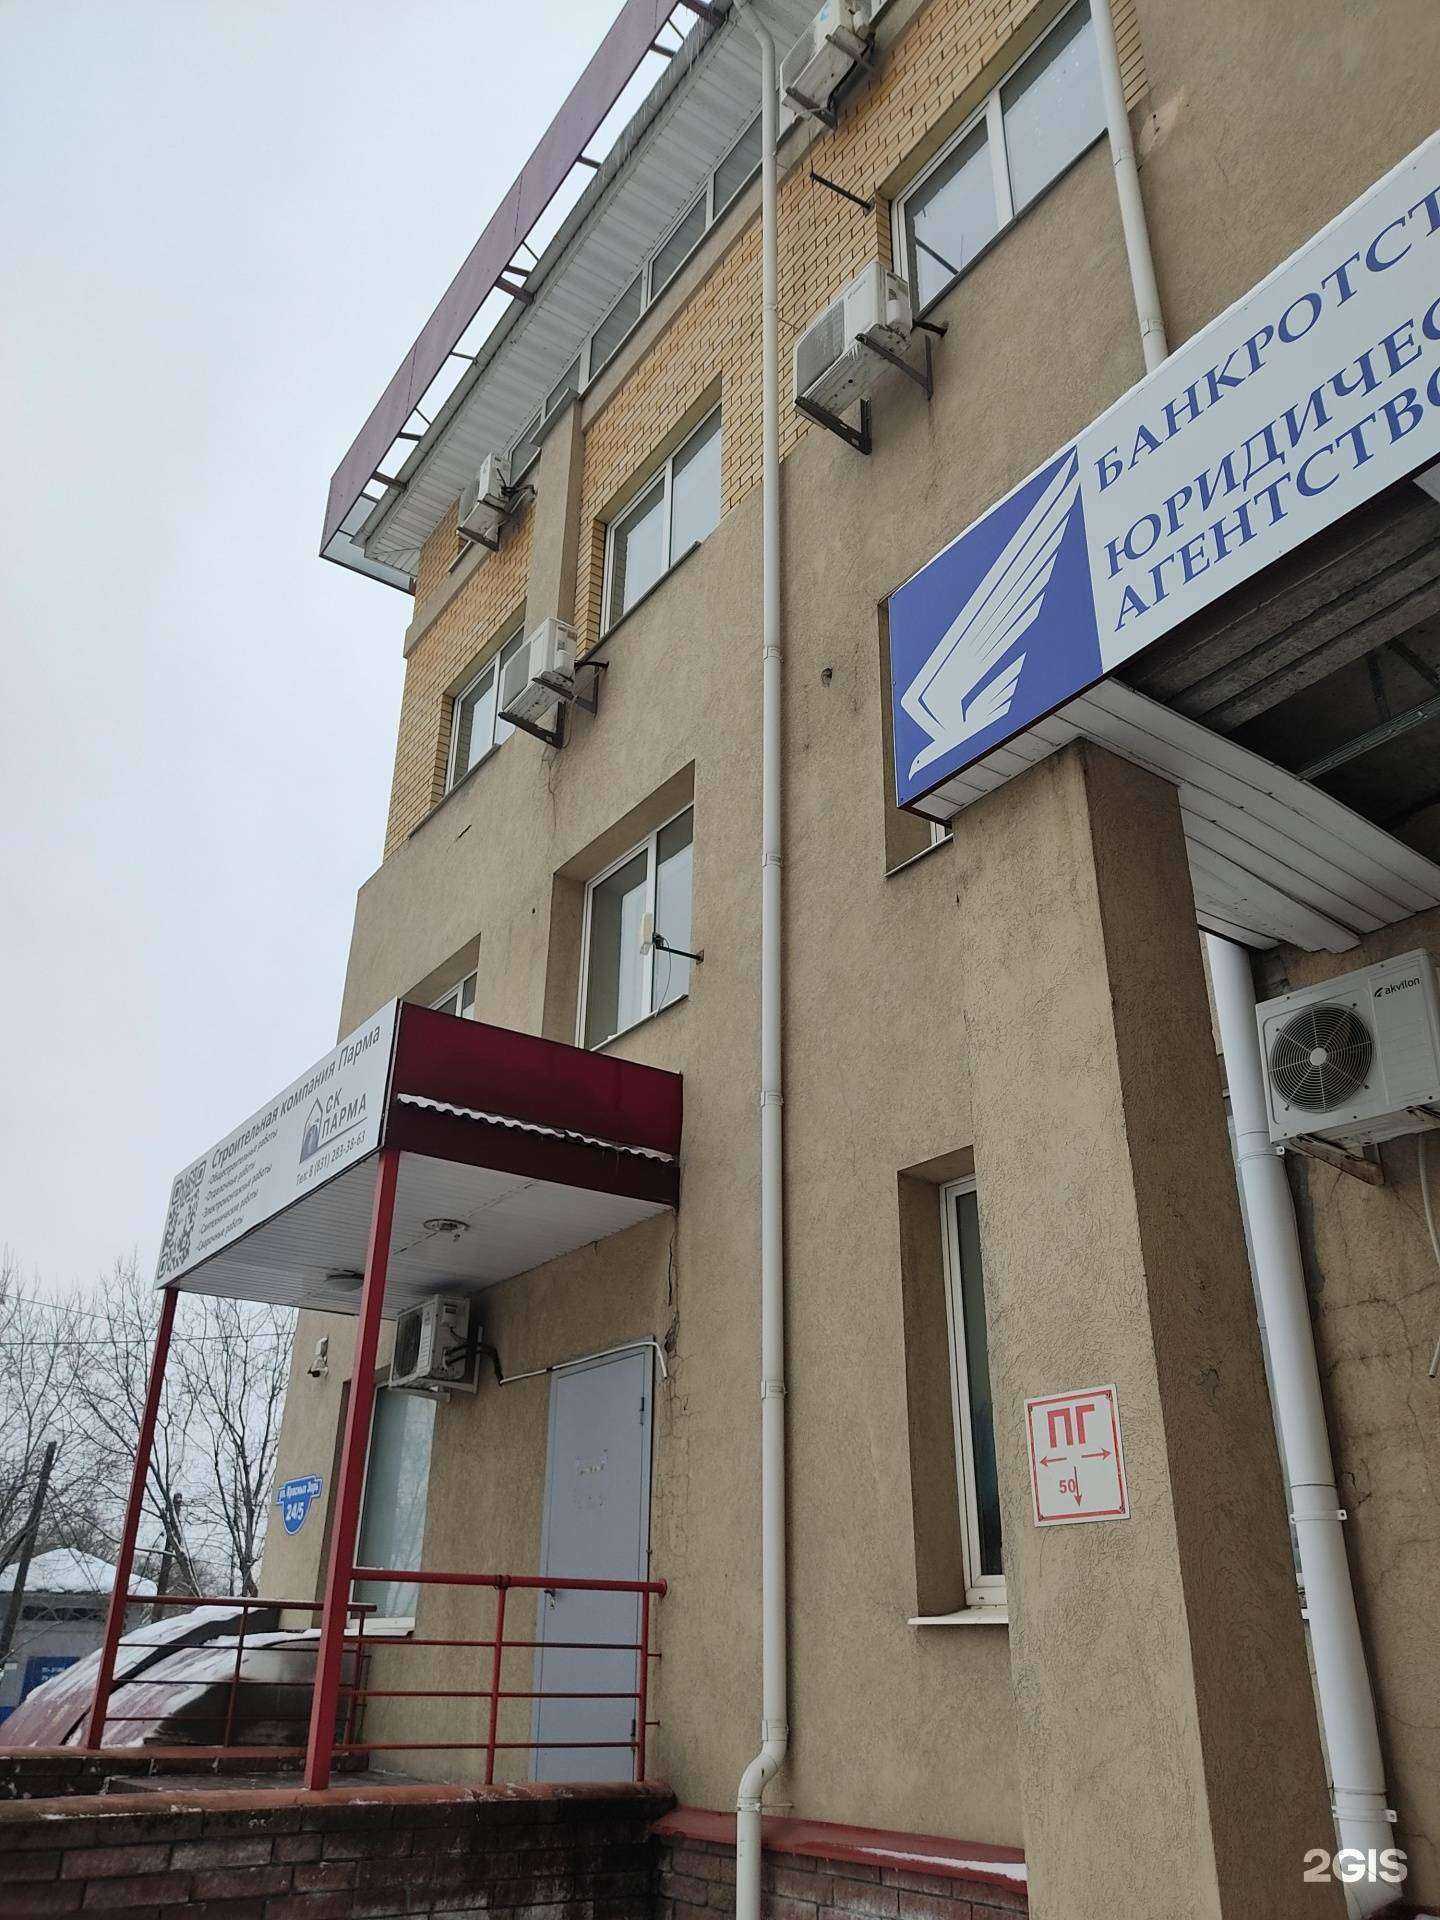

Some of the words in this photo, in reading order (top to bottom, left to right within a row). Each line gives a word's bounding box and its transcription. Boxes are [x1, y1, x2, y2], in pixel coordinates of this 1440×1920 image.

[1384, 977, 1420, 995] akvilon
[211, 1106, 279, 1169] Строительная
[280, 1060, 336, 1118] компания
[337, 1025, 381, 1071] Парма
[325, 1088, 343, 1114] СК
[321, 1093, 367, 1139] ПАРМА
[1047, 1404, 1095, 1448] ПГ
[1058, 1478, 1077, 1494] 50
